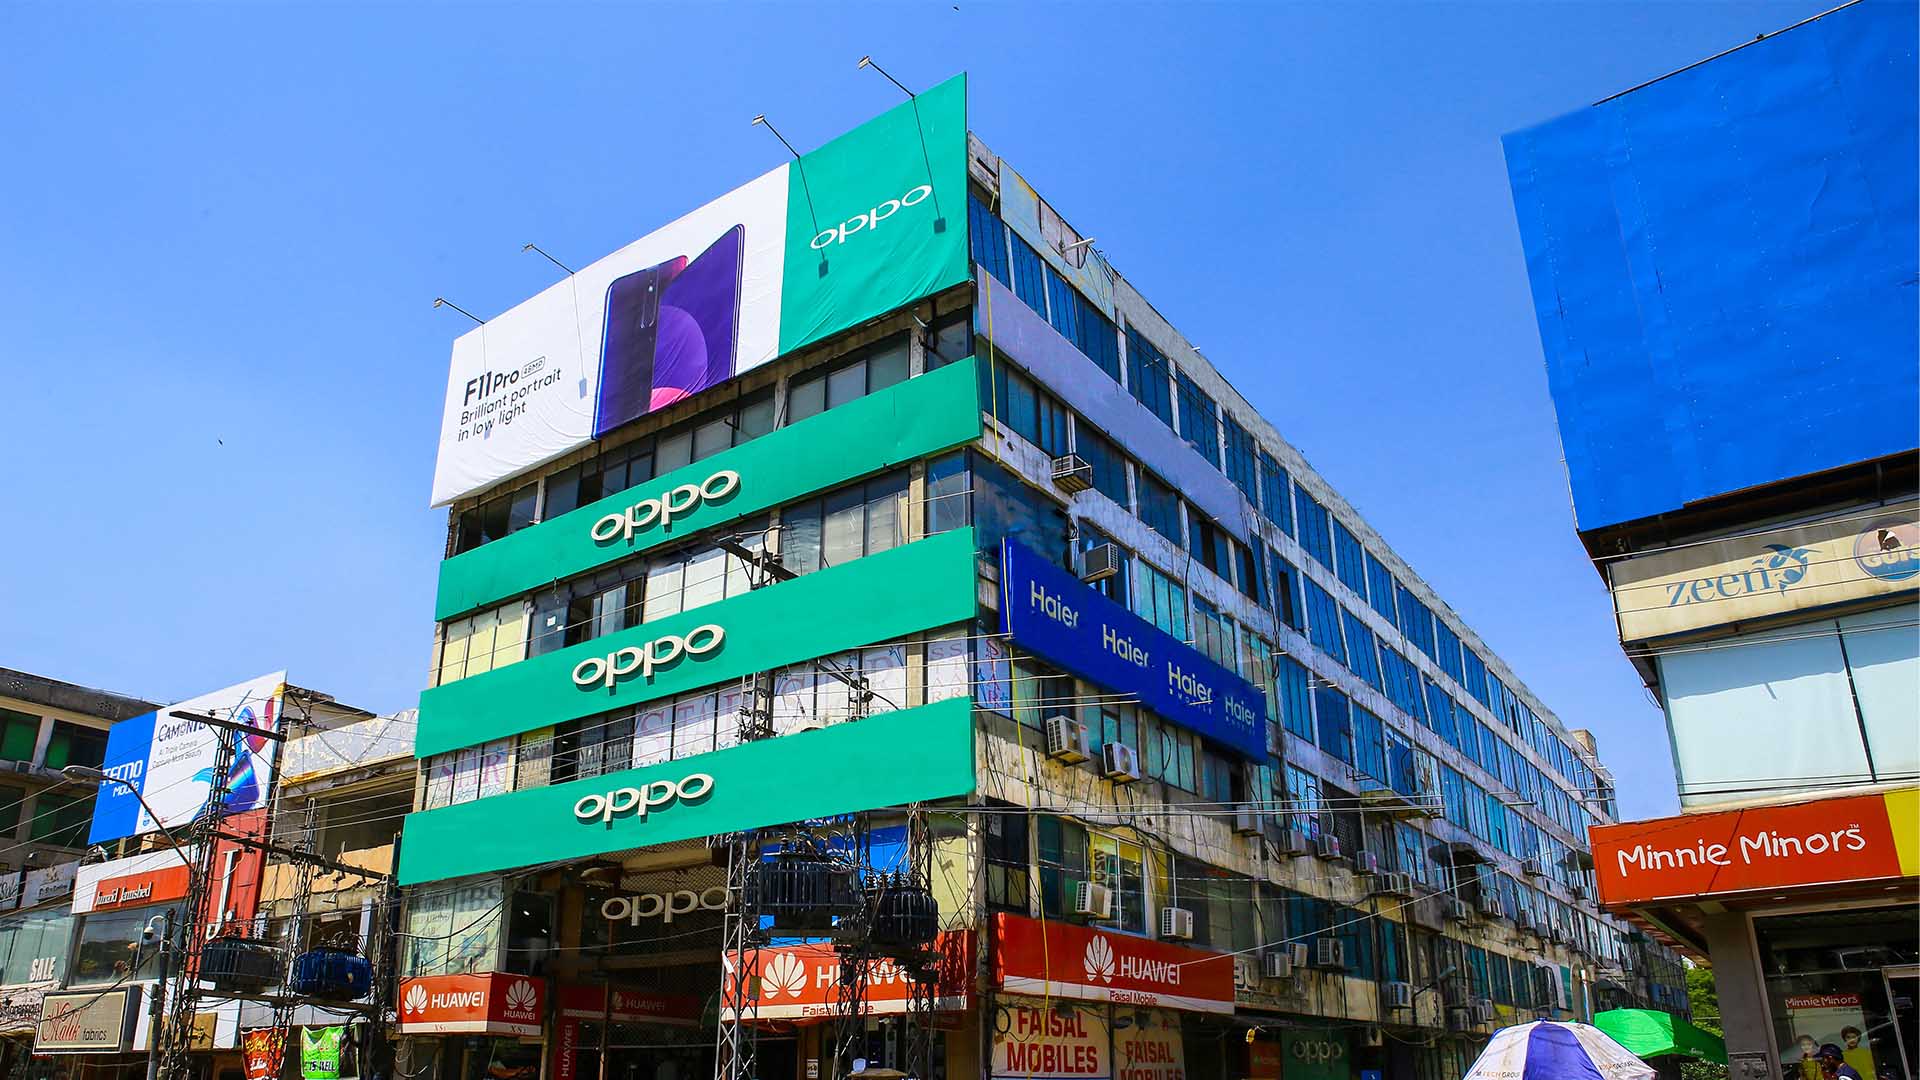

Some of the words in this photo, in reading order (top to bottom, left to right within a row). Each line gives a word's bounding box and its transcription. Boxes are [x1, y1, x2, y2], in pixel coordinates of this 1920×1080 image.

[460, 394, 507, 426] Brilliant
[510, 368, 561, 407] portrait
[458, 428, 470, 442] in
[473, 417, 496, 437] low
[498, 401, 527, 426] light
[1030, 580, 1079, 629] Haier
[1102, 624, 1149, 668] Haier
[1168, 661, 1212, 704] Haier
[1224, 696, 1256, 728] Haier
[1617, 839, 1731, 877] Minnie
[1739, 828, 1866, 865] Minors
[30, 956, 57, 981] SALE
[1120, 955, 1180, 985] HUAWEI
[431, 991, 485, 1009] HUAWEI
[626, 999, 665, 1011] HUAWEI
[802, 1004, 835, 1016] Faisal
[1109, 990, 1132, 1003] Faisal
[1134, 991, 1158, 1006] Mobile
[1785, 997, 1821, 1009] Minnie
[1821, 995, 1858, 1007] Minors
[503, 1009, 536, 1021] HUAWEI
[1017, 1007, 1088, 1039] FAISAL
[83, 1027, 107, 1041] fabrics
[562, 1024, 573, 1077] HUAWEI
[1007, 1042, 1098, 1074] MOBILES
[1125, 1040, 1175, 1064] FAISAL
